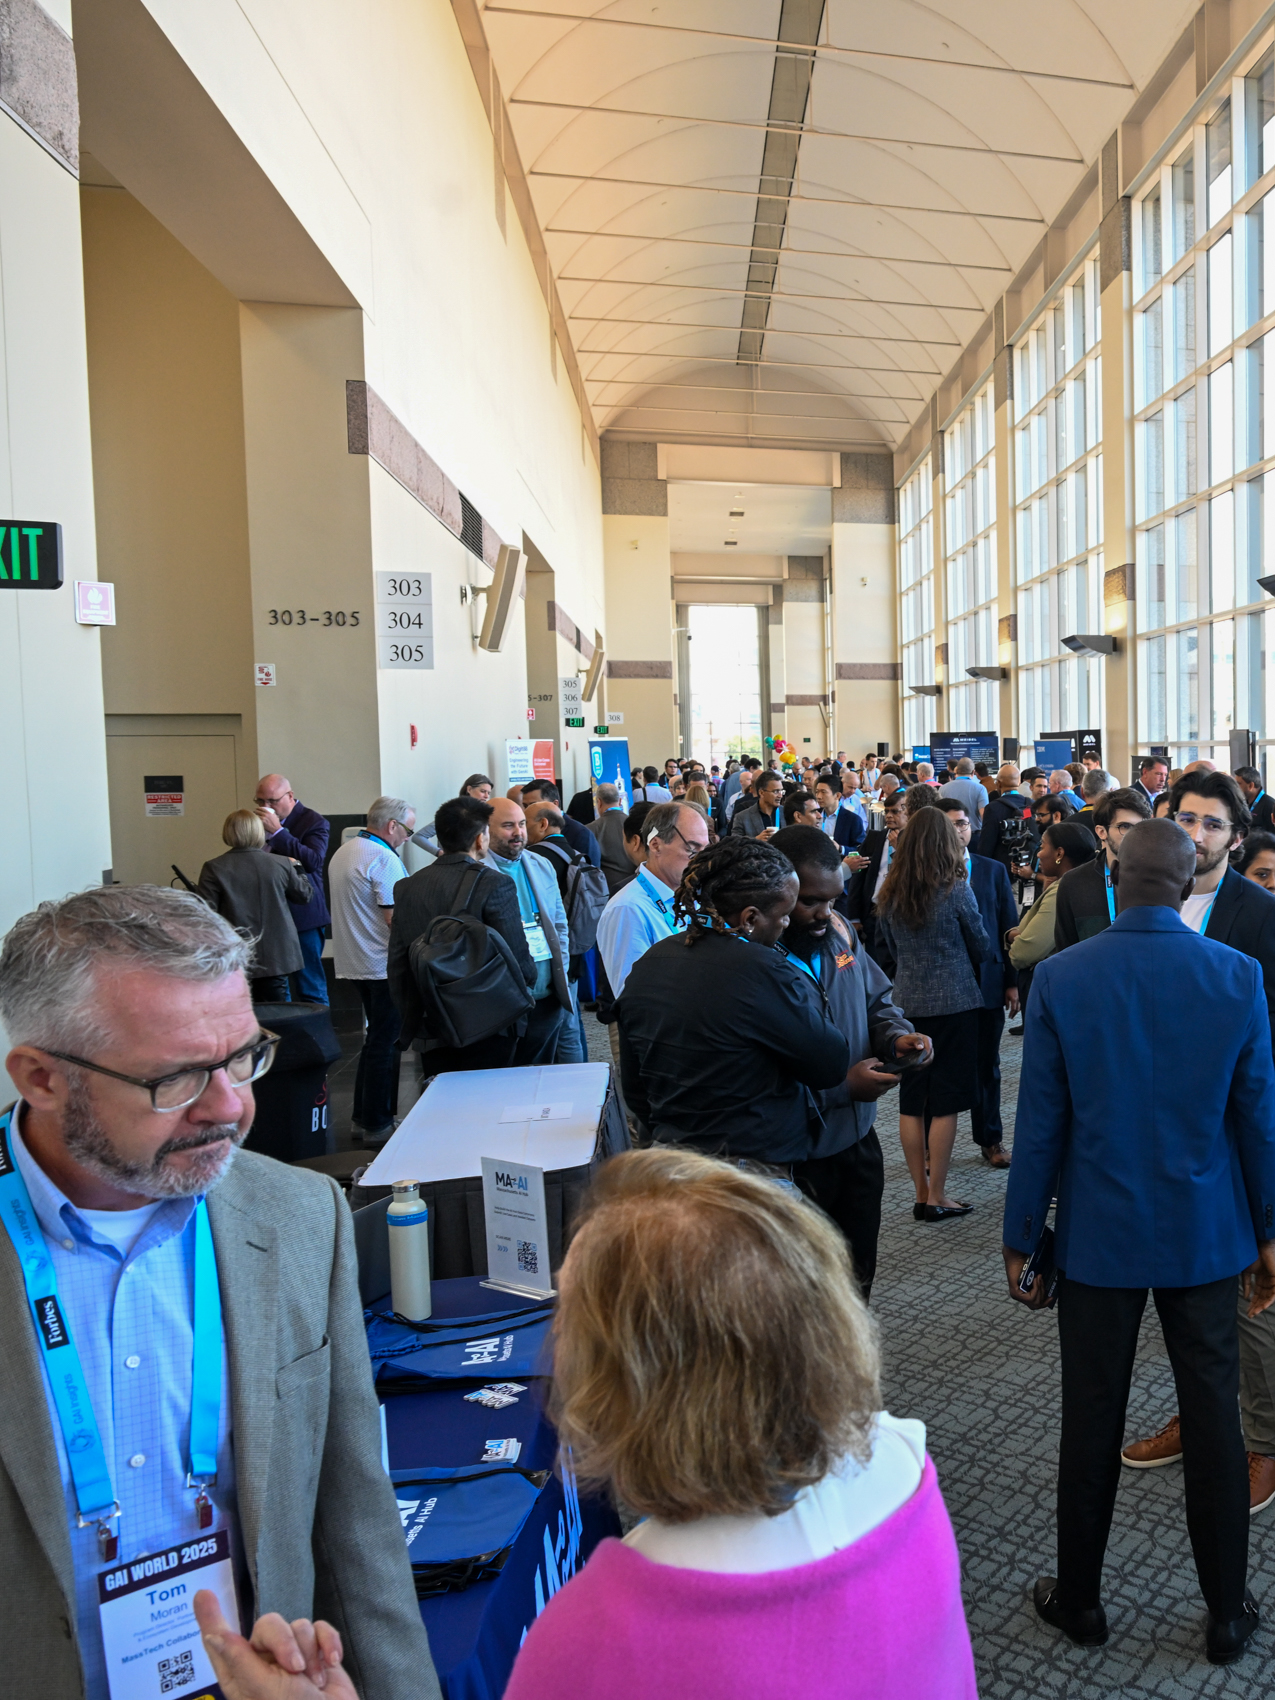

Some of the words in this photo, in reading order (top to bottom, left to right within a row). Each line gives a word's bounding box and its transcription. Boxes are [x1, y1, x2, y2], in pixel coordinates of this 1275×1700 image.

[0, 527, 43, 580] XIT
[387, 579, 423, 596] 303
[268, 610, 360, 627] 303-305
[387, 612, 424, 629] 304
[389, 645, 424, 662] 305
[563, 680, 578, 689] 305
[528, 694, 553, 702] 5-307
[563, 694, 578, 702] 306
[564, 707, 578, 716] 307
[608, 714, 621, 722] 308
[570, 718, 583, 727] EXIT
[597, 726, 608, 734] EXIT
[311, 1104, 327, 1132] BO
[11, 1199, 32, 1234] Insights
[26, 1233, 35, 1246] GAI
[43, 1299, 63, 1345] Forbes
[64, 1373, 80, 1409] Insights
[74, 1409, 84, 1425] GAI
[419, 1497, 438, 1515] Hub
[105, 1569, 129, 1591] GAI
[131, 1552, 179, 1582] WORLD
[181, 1538, 218, 1564] 2025
[146, 1584, 187, 1606] Tom
[151, 1602, 188, 1622] Moran
[121, 1640, 164, 1664] MassTech
[166, 1629, 201, 1647] Collabor
